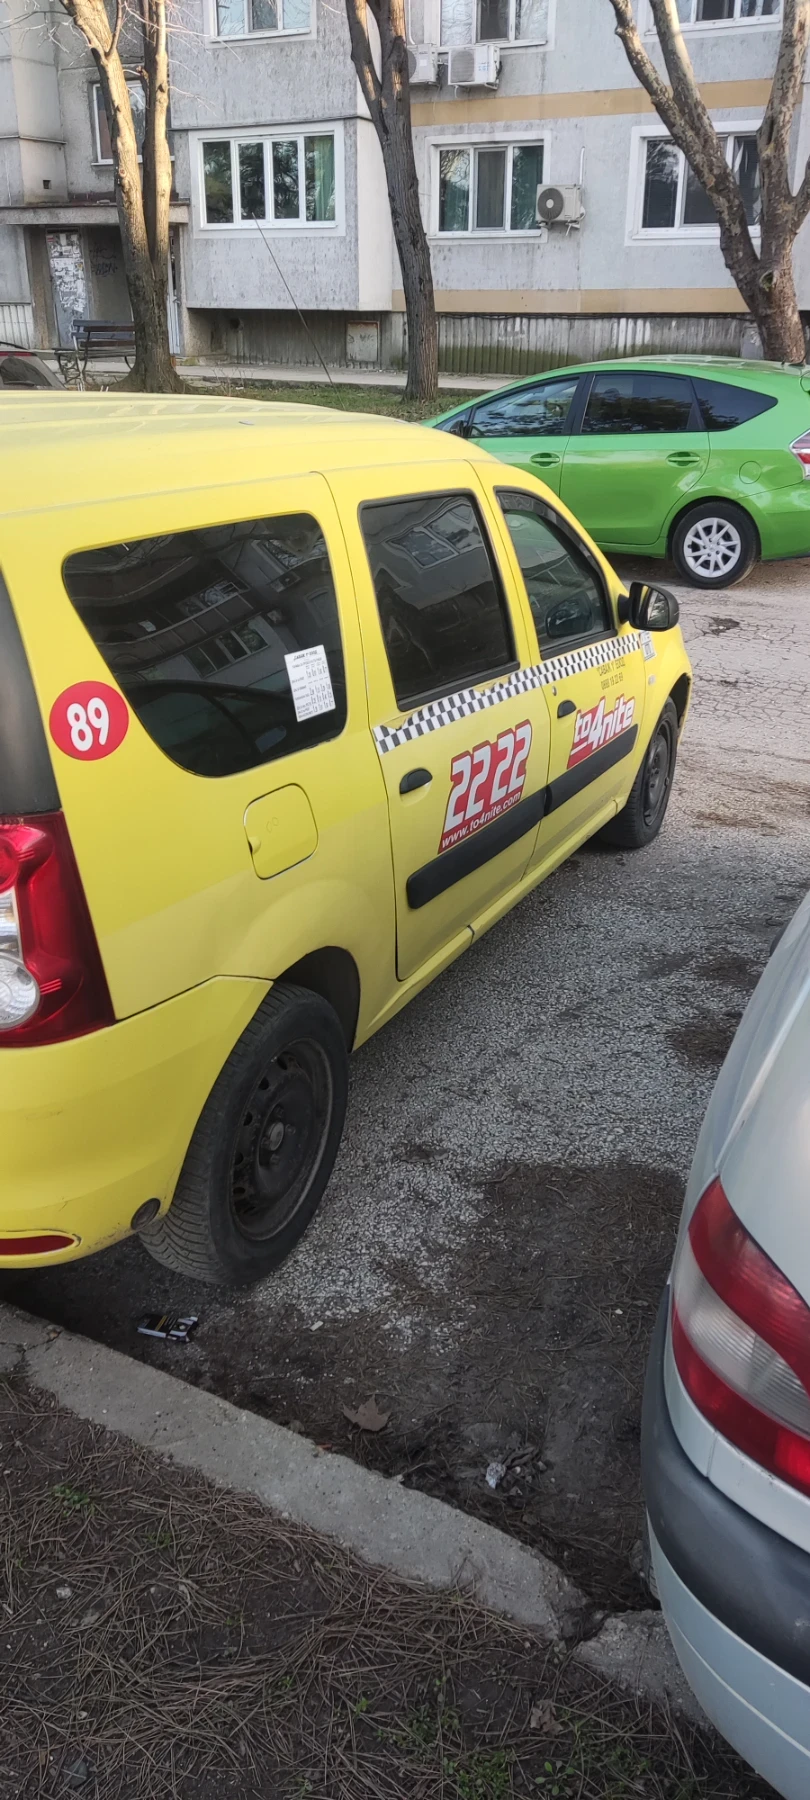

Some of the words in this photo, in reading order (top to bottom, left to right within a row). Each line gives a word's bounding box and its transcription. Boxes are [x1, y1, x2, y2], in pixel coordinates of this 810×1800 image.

[66, 697, 109, 752] 89
[571, 696, 635, 751] to4nite
[442, 791, 521, 848] www.to4nite.com
